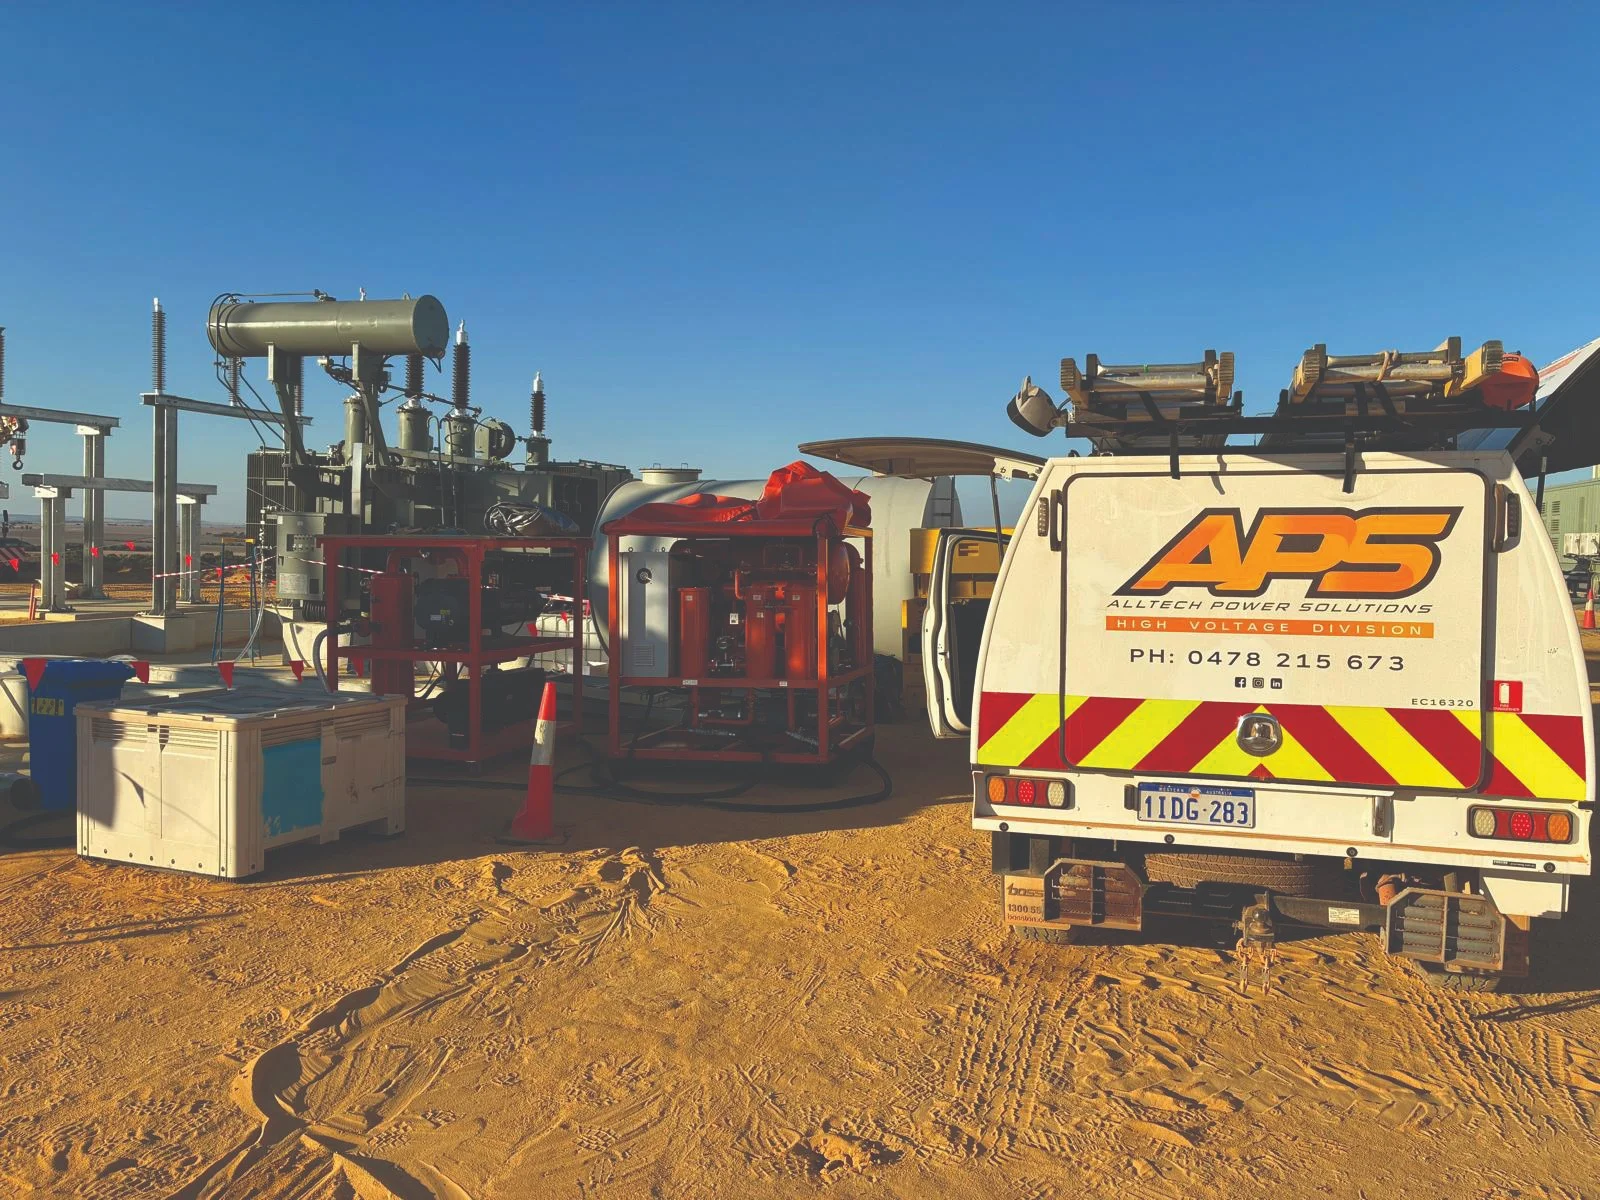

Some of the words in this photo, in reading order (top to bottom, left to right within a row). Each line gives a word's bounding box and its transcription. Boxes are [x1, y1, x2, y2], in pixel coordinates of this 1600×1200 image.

[1112, 506, 1464, 599] APS
[1106, 599, 1203, 611] ALLTECH
[1209, 601, 1292, 612] POWER
[1299, 602, 1434, 614] SOLUTIONS
[1116, 618, 1168, 630] HIGH
[1188, 620, 1290, 633] VOLTAGE
[1312, 623, 1422, 636] DIVISION
[1130, 648, 1174, 664] PH:
[1187, 650, 1261, 667] 0478
[1276, 652, 1331, 669] 215
[1346, 655, 1404, 672] 673
[1411, 697, 1475, 708] EC16320
